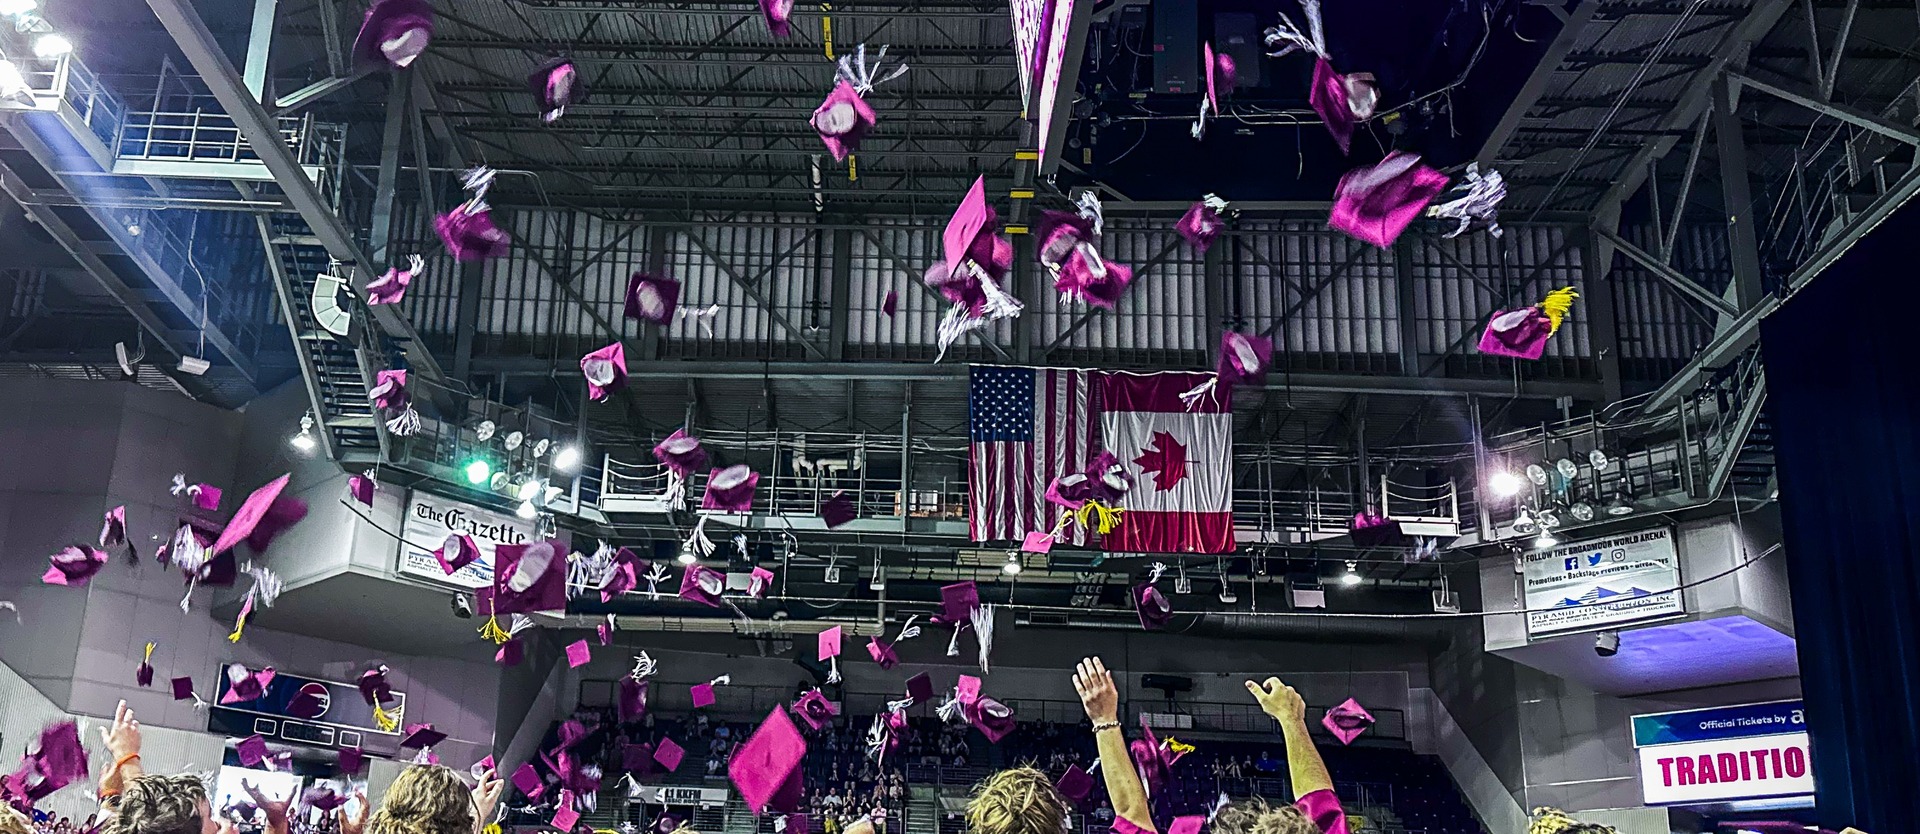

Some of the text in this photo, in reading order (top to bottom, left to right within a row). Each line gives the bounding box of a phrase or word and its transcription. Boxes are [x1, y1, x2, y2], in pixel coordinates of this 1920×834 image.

[417, 503, 525, 544] The Gazette
[1526, 531, 1666, 562] FOLLOW THE BROADMOOR WORLD ARENA!
[1529, 575, 1562, 586] Promotions
[1568, 570, 1599, 580] Backstage
[1531, 611, 1575, 621] PYRAMID
[1699, 709, 1805, 730] Official Tickets by a
[1657, 746, 1807, 787] TRADITIO
